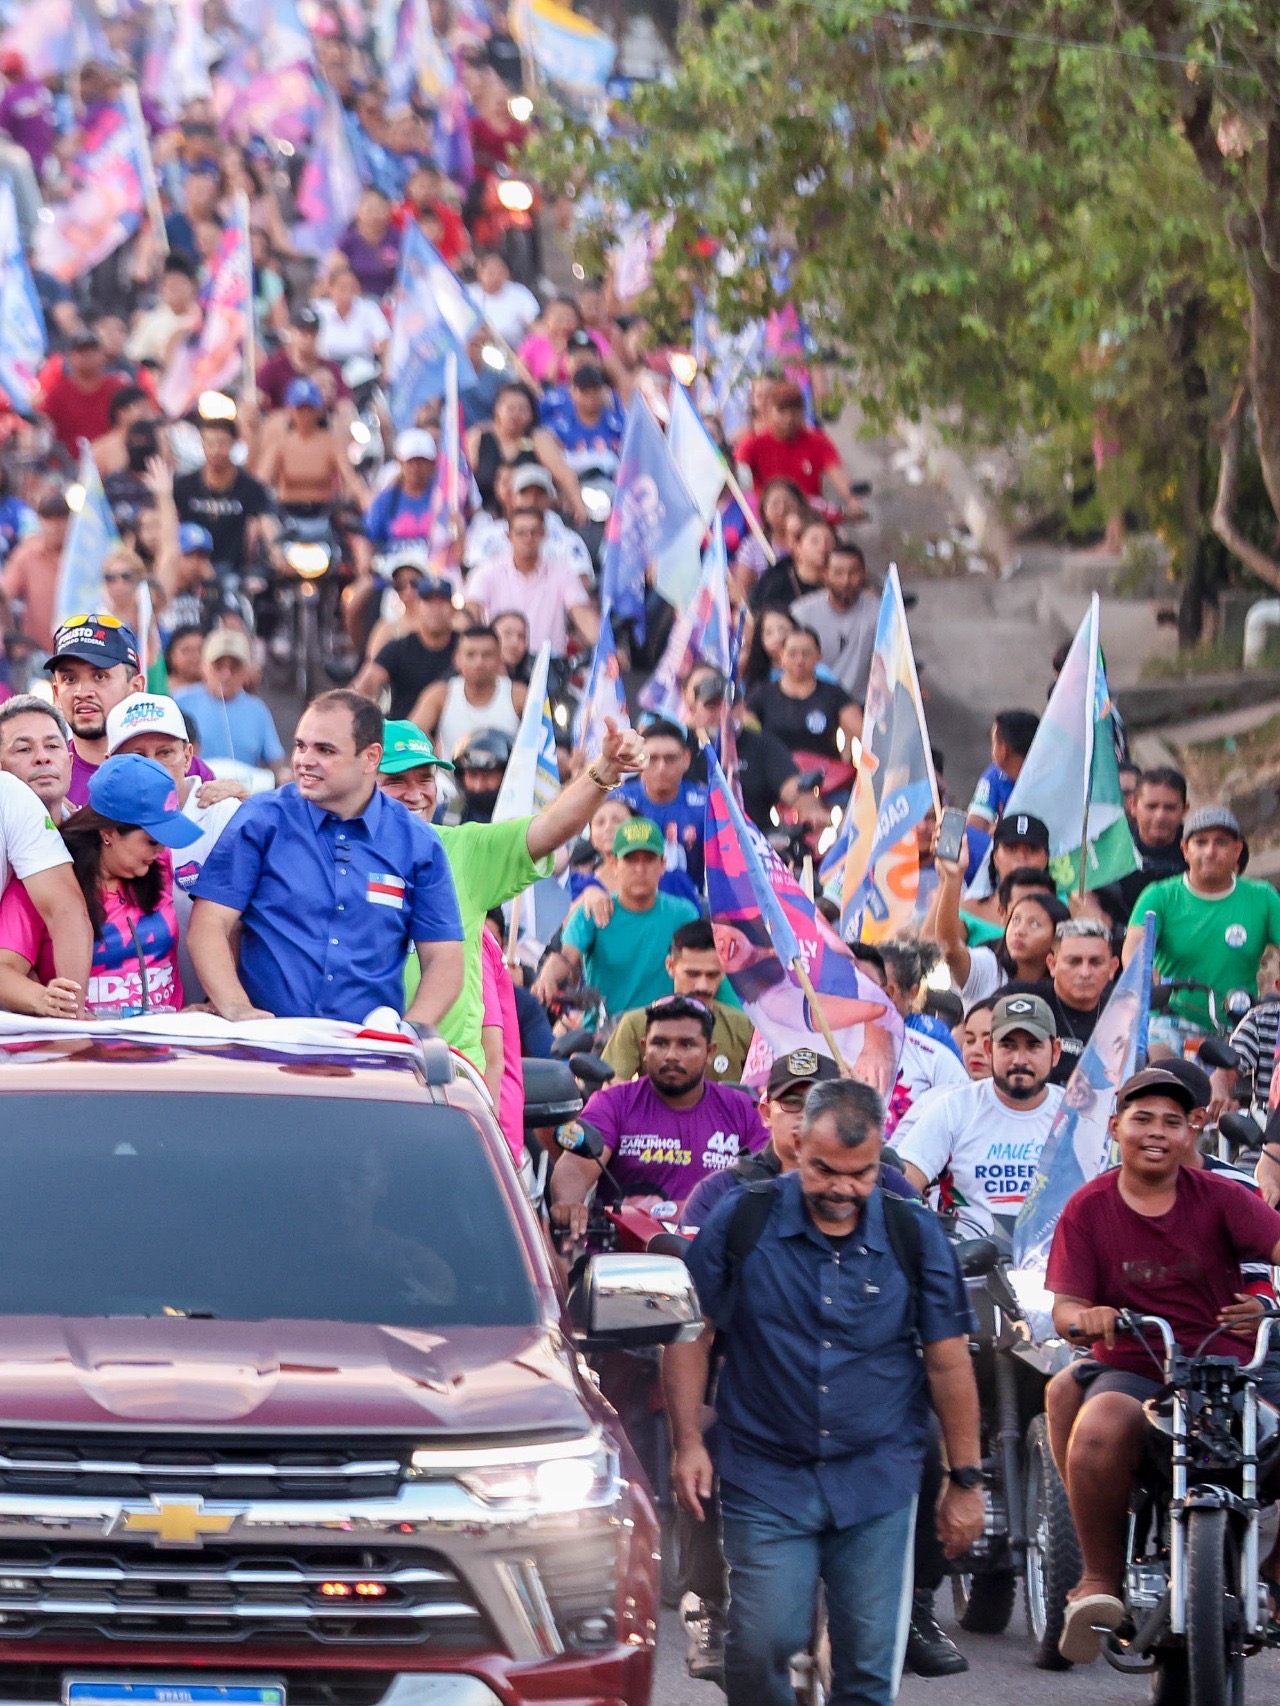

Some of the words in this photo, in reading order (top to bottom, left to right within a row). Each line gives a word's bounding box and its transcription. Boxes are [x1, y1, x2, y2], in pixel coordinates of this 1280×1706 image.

[94, 630, 107, 640] JR
[87, 964, 174, 1004] IDADE
[707, 1130, 740, 1156] 44
[975, 1165, 1037, 1178] ROBER
[984, 1180, 1031, 1193] CIDA
